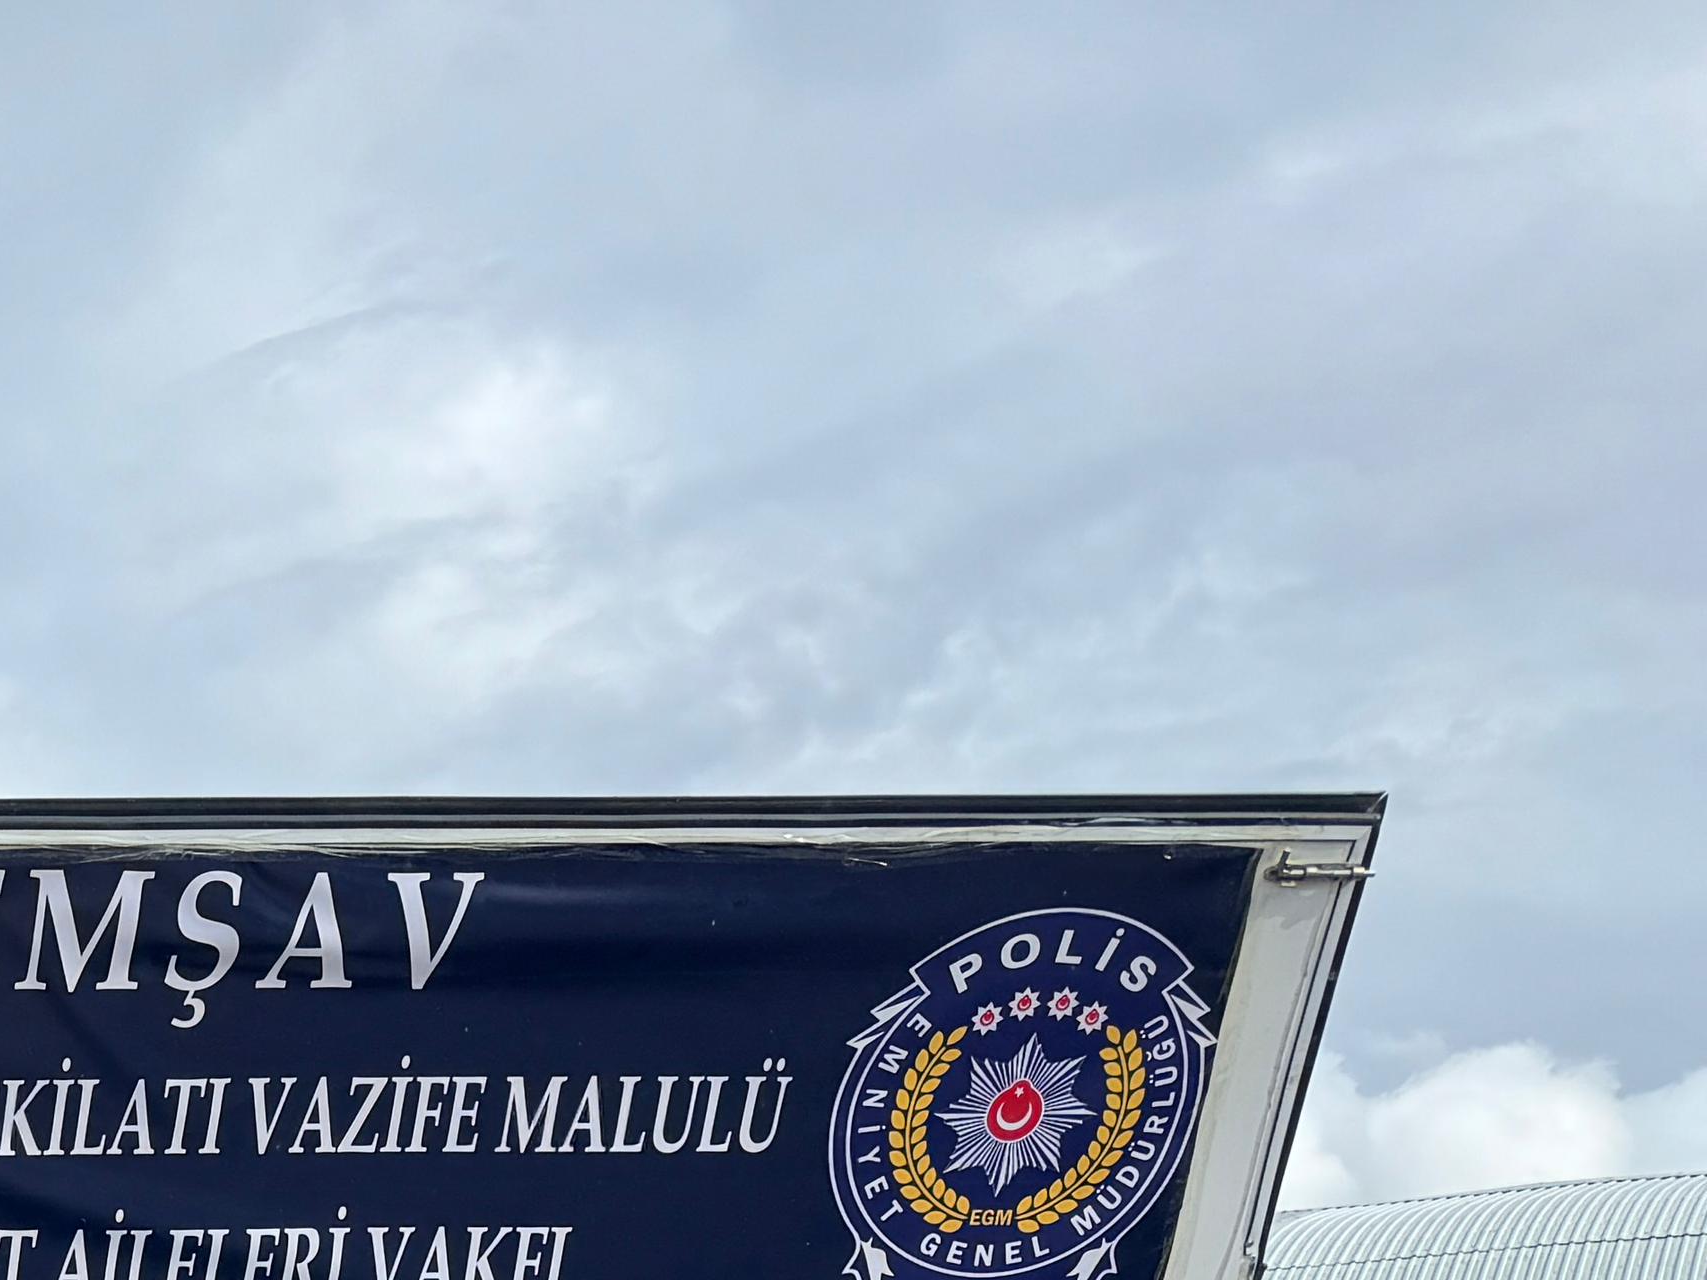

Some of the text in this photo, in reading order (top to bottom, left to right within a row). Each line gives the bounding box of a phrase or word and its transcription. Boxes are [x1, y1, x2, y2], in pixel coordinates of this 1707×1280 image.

[948, 927, 1157, 994] POLİS
[249, 1055, 487, 1155] VAZİFE
[494, 1056, 793, 1154] MALULÜ
[856, 1014, 1178, 1267] EMNİYET GENEL MÜDÜRLÜĞÜ
[968, 1207, 1015, 1227] EGM
